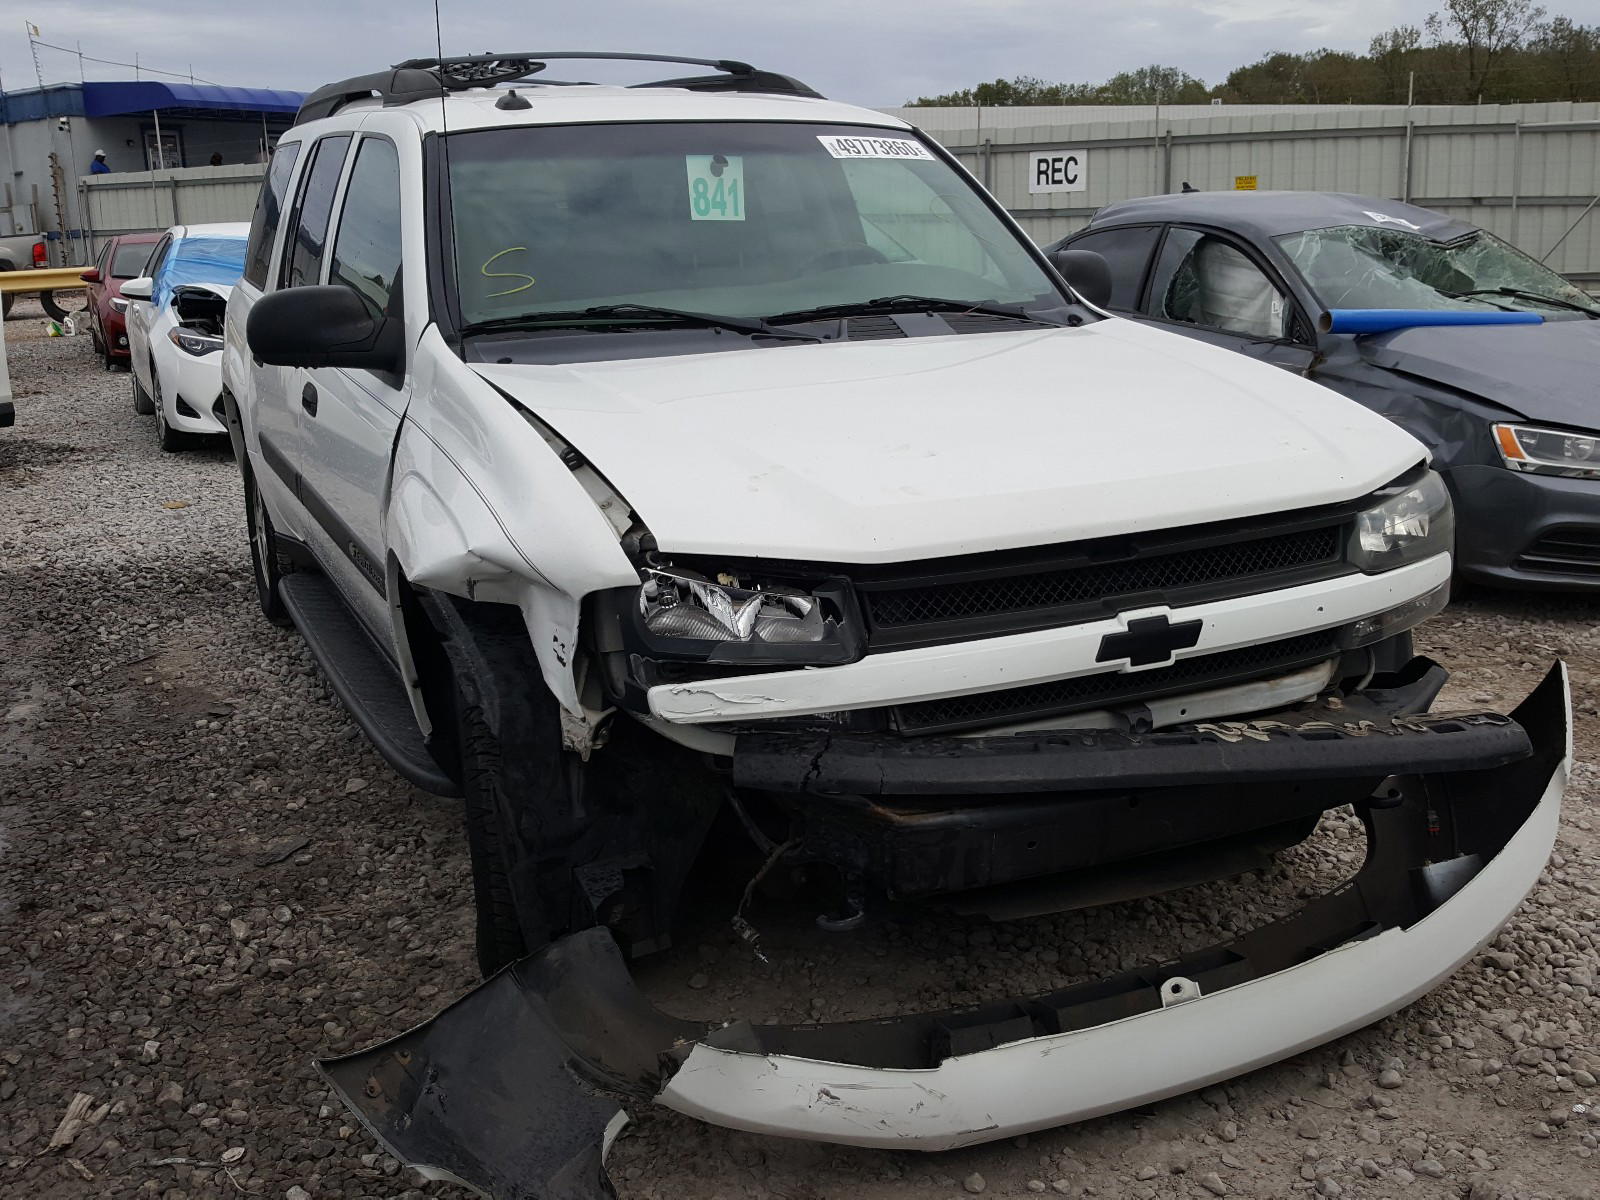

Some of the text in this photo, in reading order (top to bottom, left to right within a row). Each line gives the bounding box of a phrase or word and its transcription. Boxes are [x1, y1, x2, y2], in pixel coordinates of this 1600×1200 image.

[835, 138, 919, 156] 49773860
[1036, 156, 1079, 186] REC
[692, 177, 740, 217] 841
